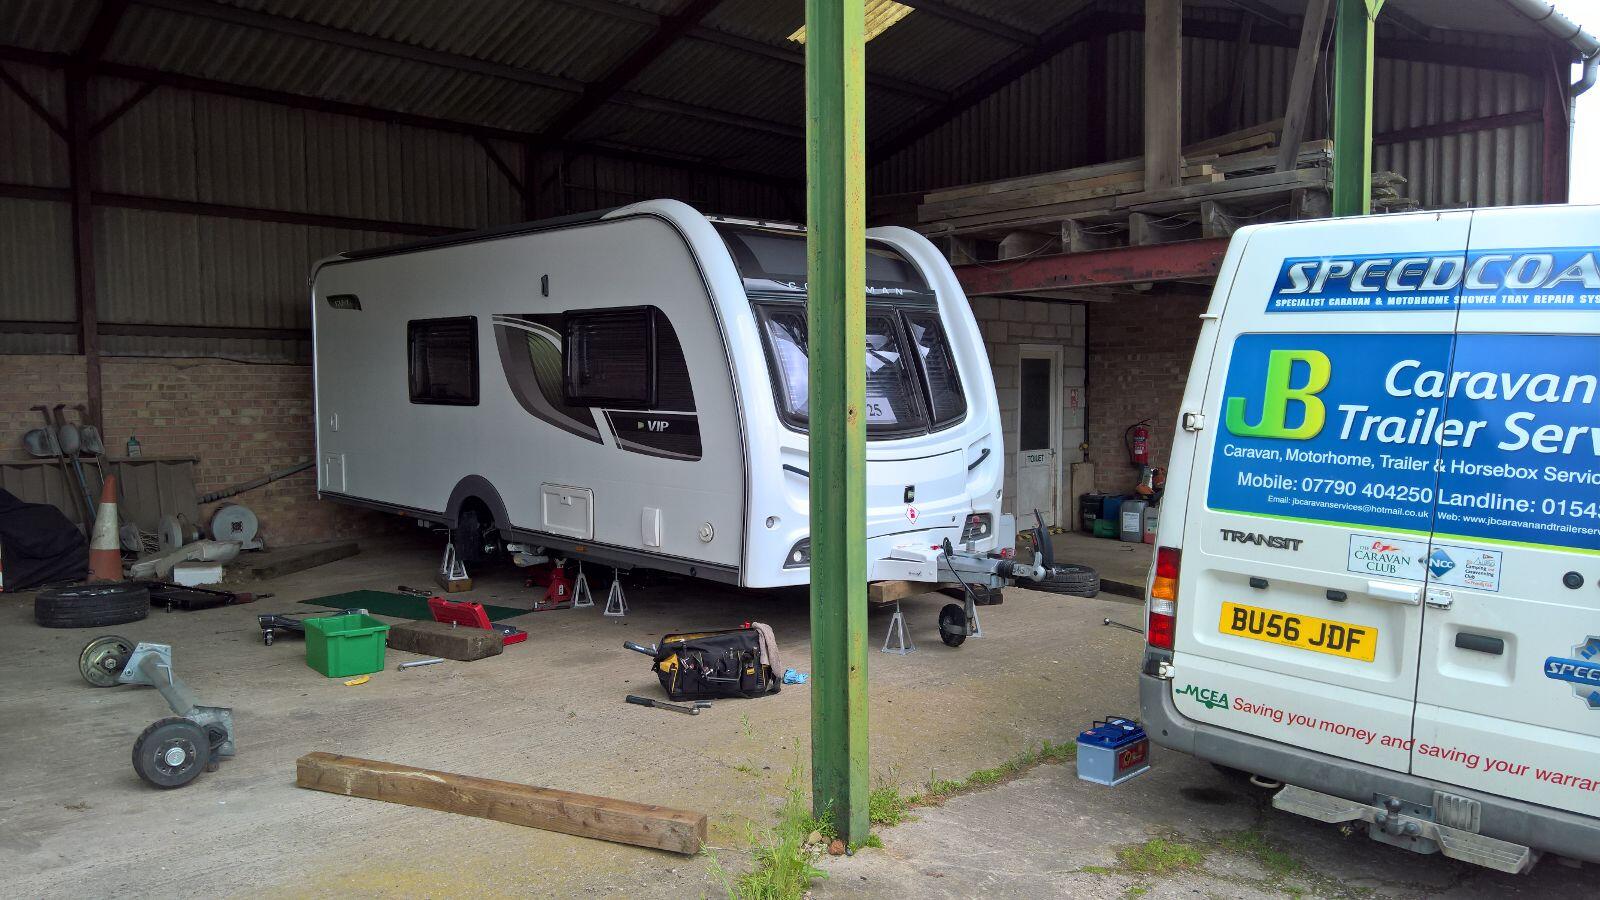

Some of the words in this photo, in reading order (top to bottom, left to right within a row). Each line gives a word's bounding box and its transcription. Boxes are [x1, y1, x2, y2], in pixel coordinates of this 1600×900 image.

[1275, 299, 1325, 307] SPECIALIST
[1329, 298, 1370, 306] CARAVAN
[1387, 296, 1450, 305] MOTORHOME
[1453, 295, 1497, 304] SHOWER
[1502, 295, 1529, 304] TRAY
[1533, 294, 1574, 304] REPAIR
[1385, 360, 1597, 404] Caravan
[647, 420, 670, 432] VIP
[1338, 405, 1487, 448] Trailer
[1027, 454, 1045, 463] TOILET
[1224, 444, 1282, 462] Caravan,
[1285, 448, 1375, 470] Motorhome,
[1380, 454, 1429, 471] Trailer
[1433, 458, 1446, 473] &
[1451, 460, 1538, 480] Horsebox
[1238, 471, 1297, 491] Mobile:
[1302, 477, 1356, 496] 07790
[1361, 483, 1433, 504] 404250
[1438, 488, 1535, 513] Landline:
[1541, 498, 1600, 519] 0154
[1268, 495, 1291, 504] Email:
[1292, 498, 1429, 519] jbcaravanservices@hotmail.co.uk
[1438, 512, 1461, 522] Web:
[1220, 528, 1303, 551] TRANSIT
[1354, 550, 1411, 566] CARAVAN
[1366, 561, 1397, 574] CLUB
[1429, 559, 1454, 569] NCC
[1231, 606, 1301, 642] BU56
[1308, 622, 1366, 653] JDF
[1184, 684, 1229, 709] MCEA
[1233, 697, 1283, 723] Saving
[1287, 712, 1317, 728] you
[1319, 719, 1376, 745] money
[1380, 734, 1416, 751] and
[1418, 742, 1480, 769] saving
[1483, 757, 1530, 777] your
